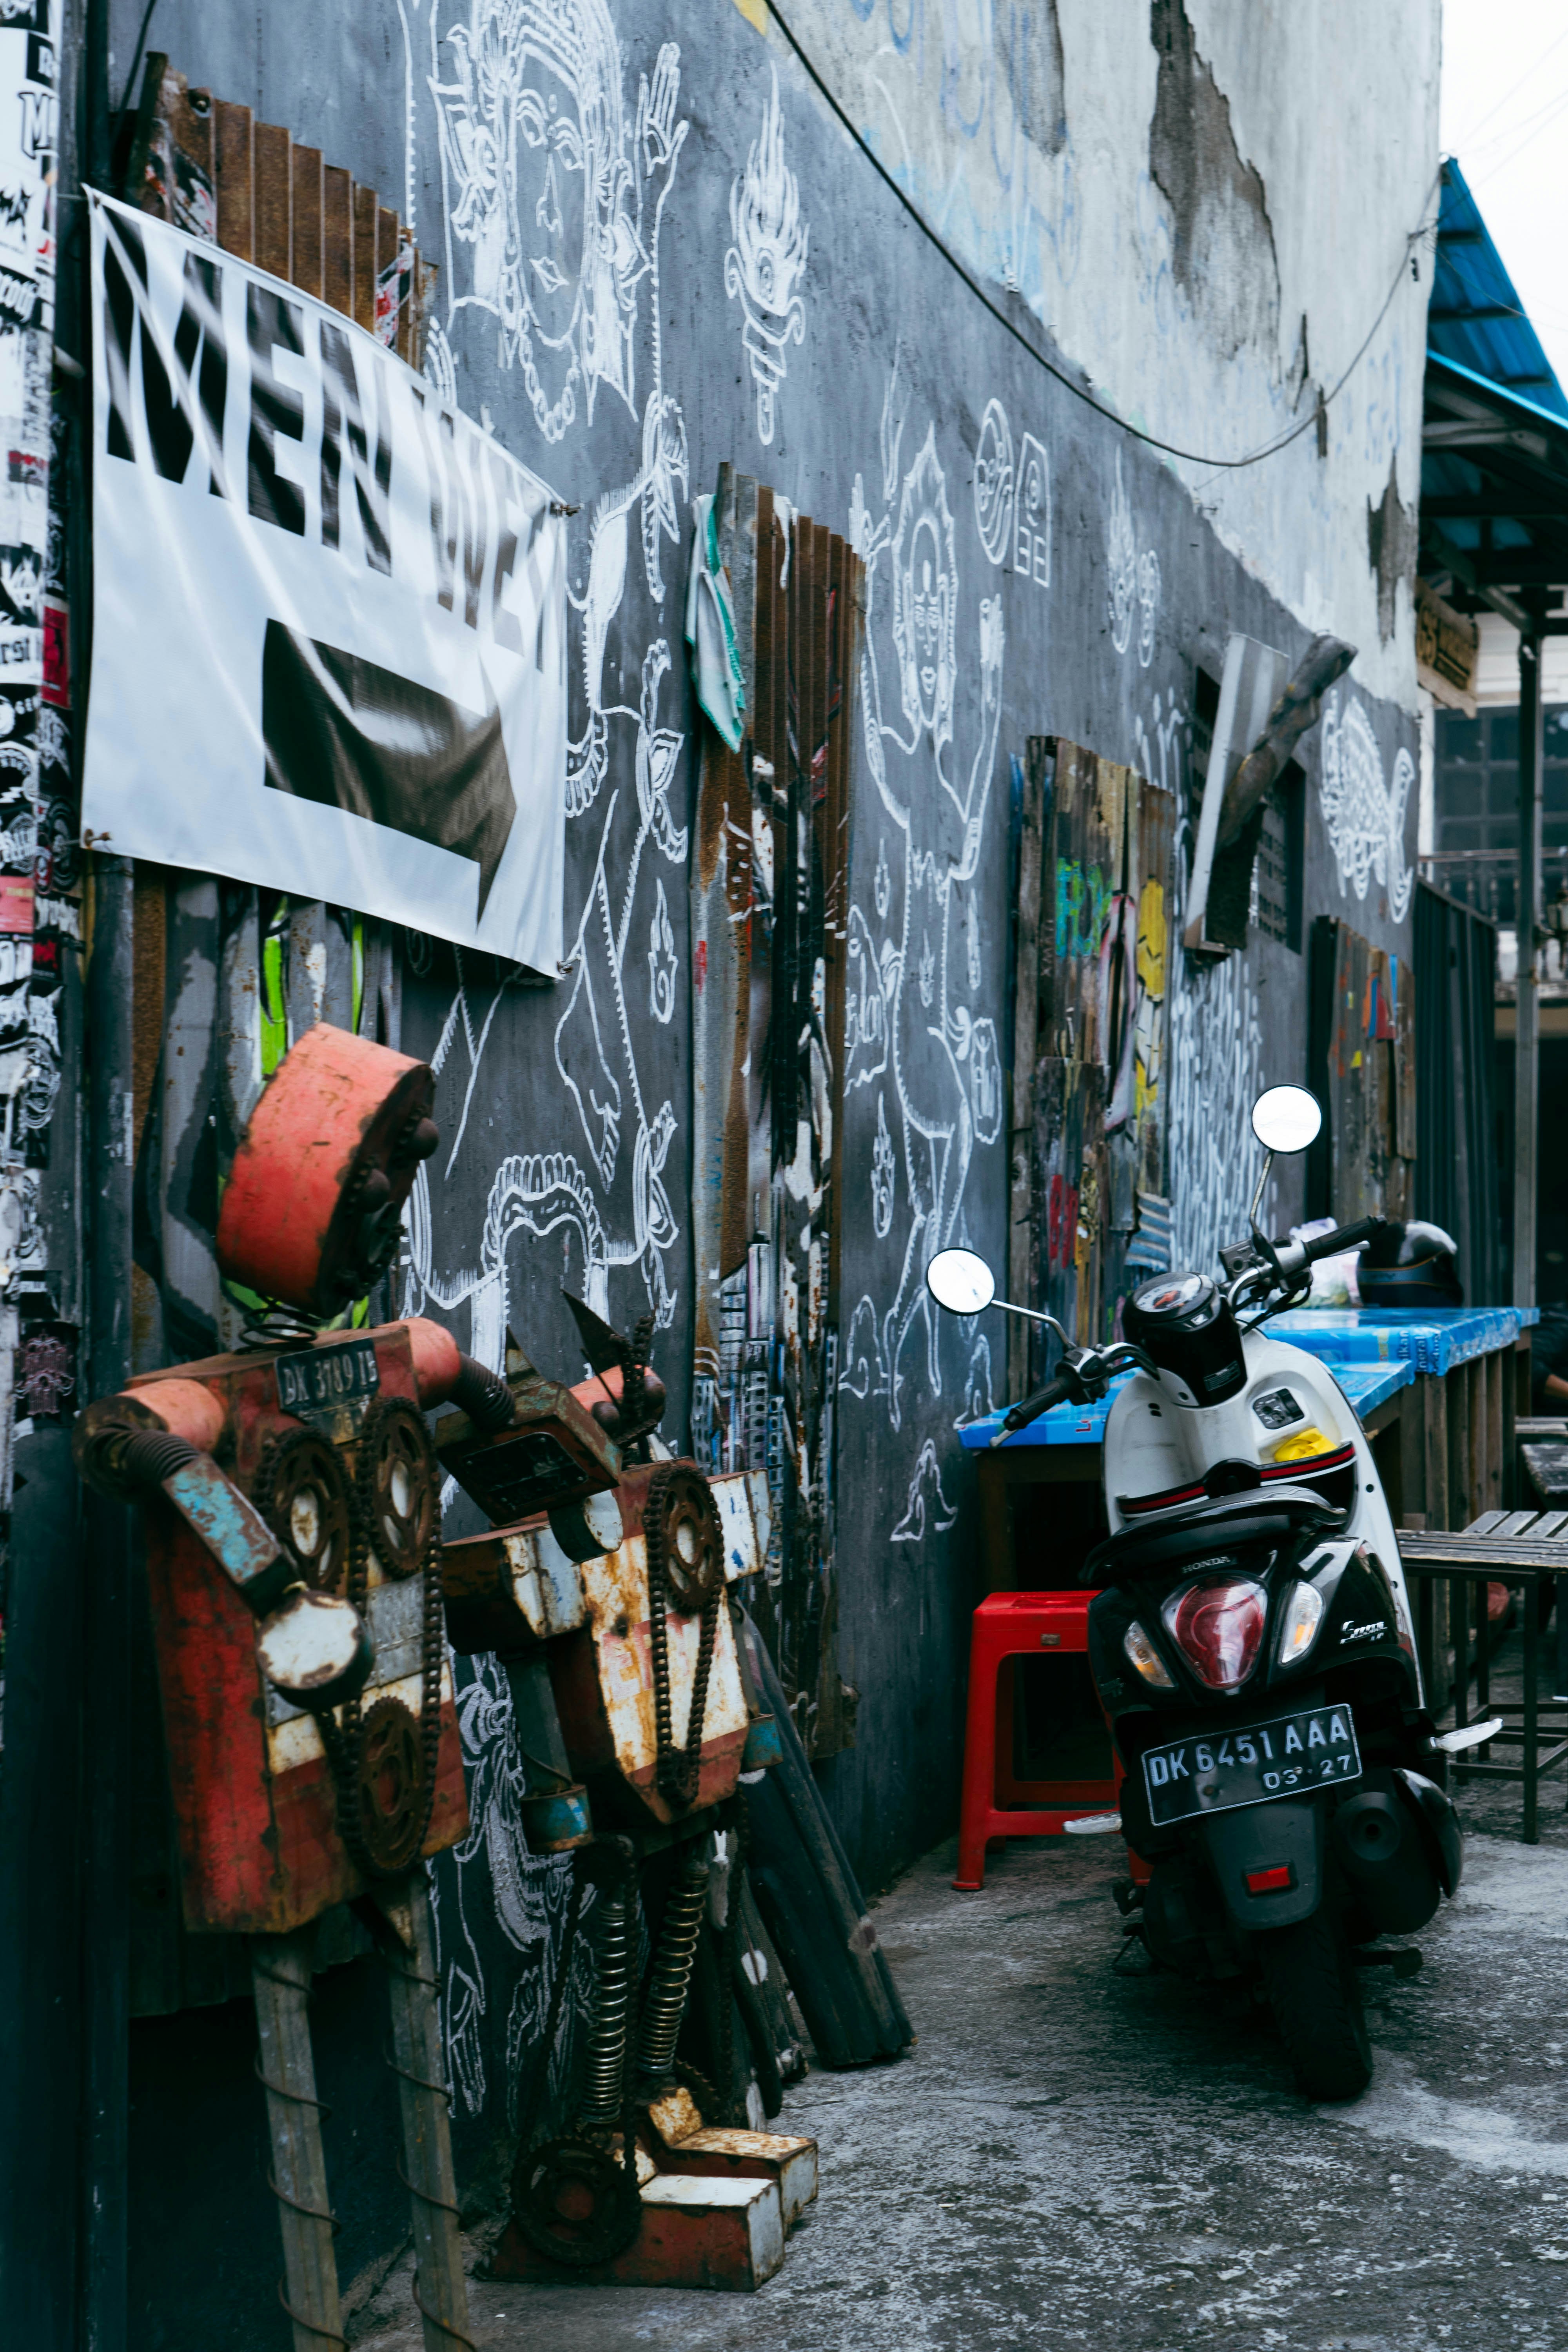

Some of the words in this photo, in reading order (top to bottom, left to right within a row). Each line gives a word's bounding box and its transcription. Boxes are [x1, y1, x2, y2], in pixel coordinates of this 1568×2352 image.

[103, 205, 392, 577] MEN
[1182, 1556, 1230, 1573] HONDA
[1149, 1749, 1189, 1786] DK
[1196, 1731, 1274, 1772] 6451
[1286, 1715, 1348, 1754] AAA
